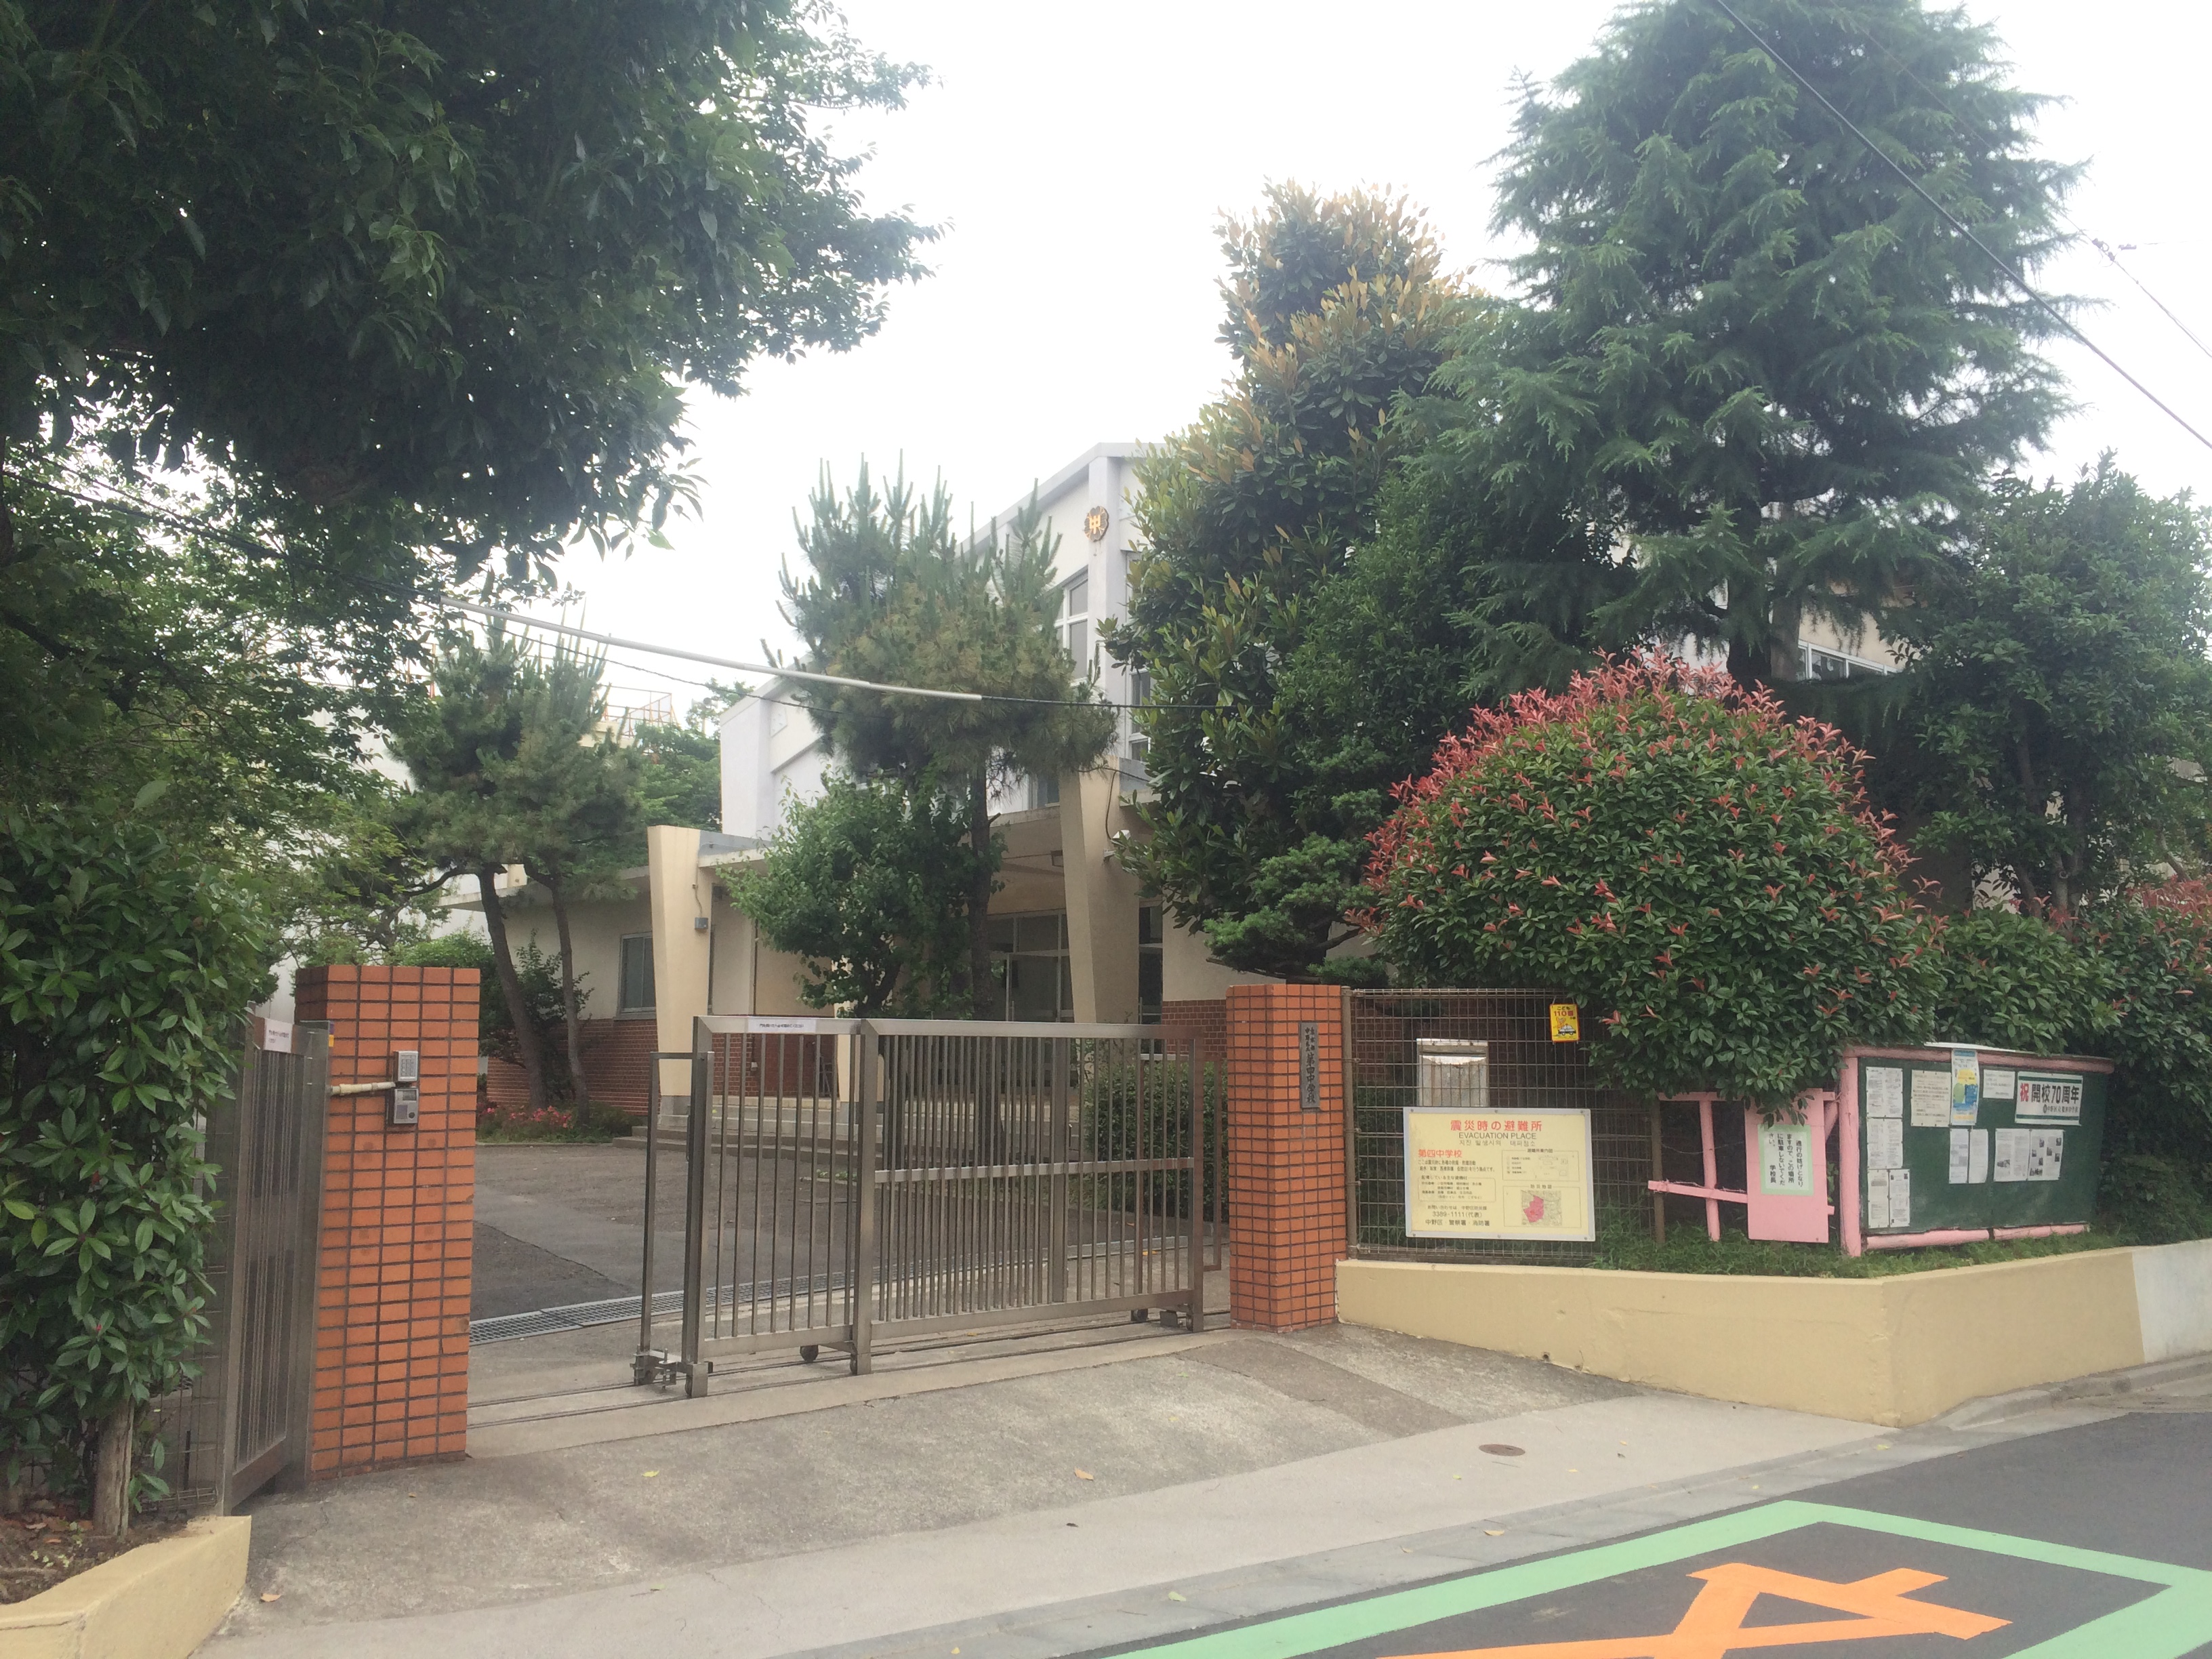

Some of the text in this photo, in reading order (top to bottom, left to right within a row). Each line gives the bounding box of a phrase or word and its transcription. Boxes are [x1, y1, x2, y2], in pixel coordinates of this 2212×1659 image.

[1306, 1052, 1316, 1103] 第四中学校
[2020, 1082, 2029, 1102] 祝
[2031, 1084, 2080, 1105] 開校70周年
[1450, 1120, 1542, 1132] 震災時の避難所
[1418, 1149, 1462, 1158] 第四中学校
[1777, 1133, 1786, 1186] に駐車しないでくだ
[1786, 1133, 1795, 1183] ますので、この場所
